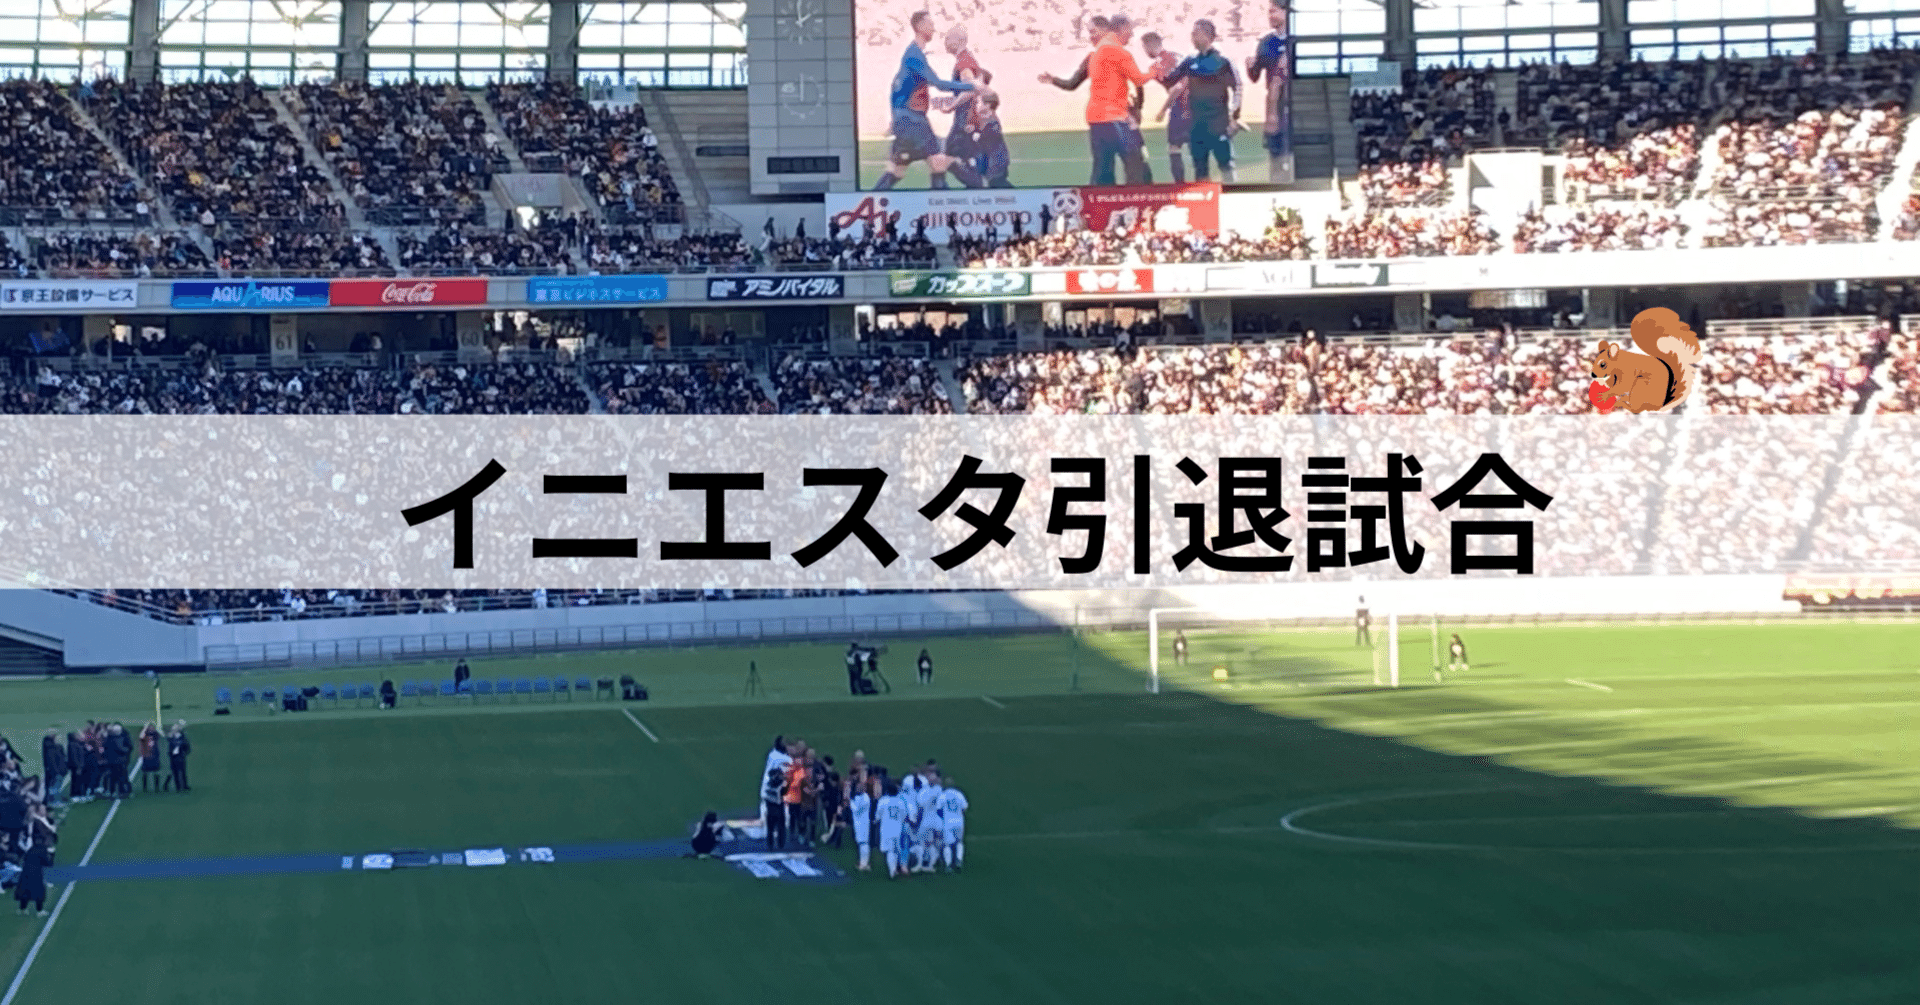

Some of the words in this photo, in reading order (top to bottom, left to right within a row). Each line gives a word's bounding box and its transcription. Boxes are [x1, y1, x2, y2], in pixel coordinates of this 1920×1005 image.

[22, 288, 134, 303] 京王設備サービス
[211, 282, 296, 305] AQUARIUS
[741, 278, 841, 298] アミノバイタル
[274, 335, 293, 351] 61
